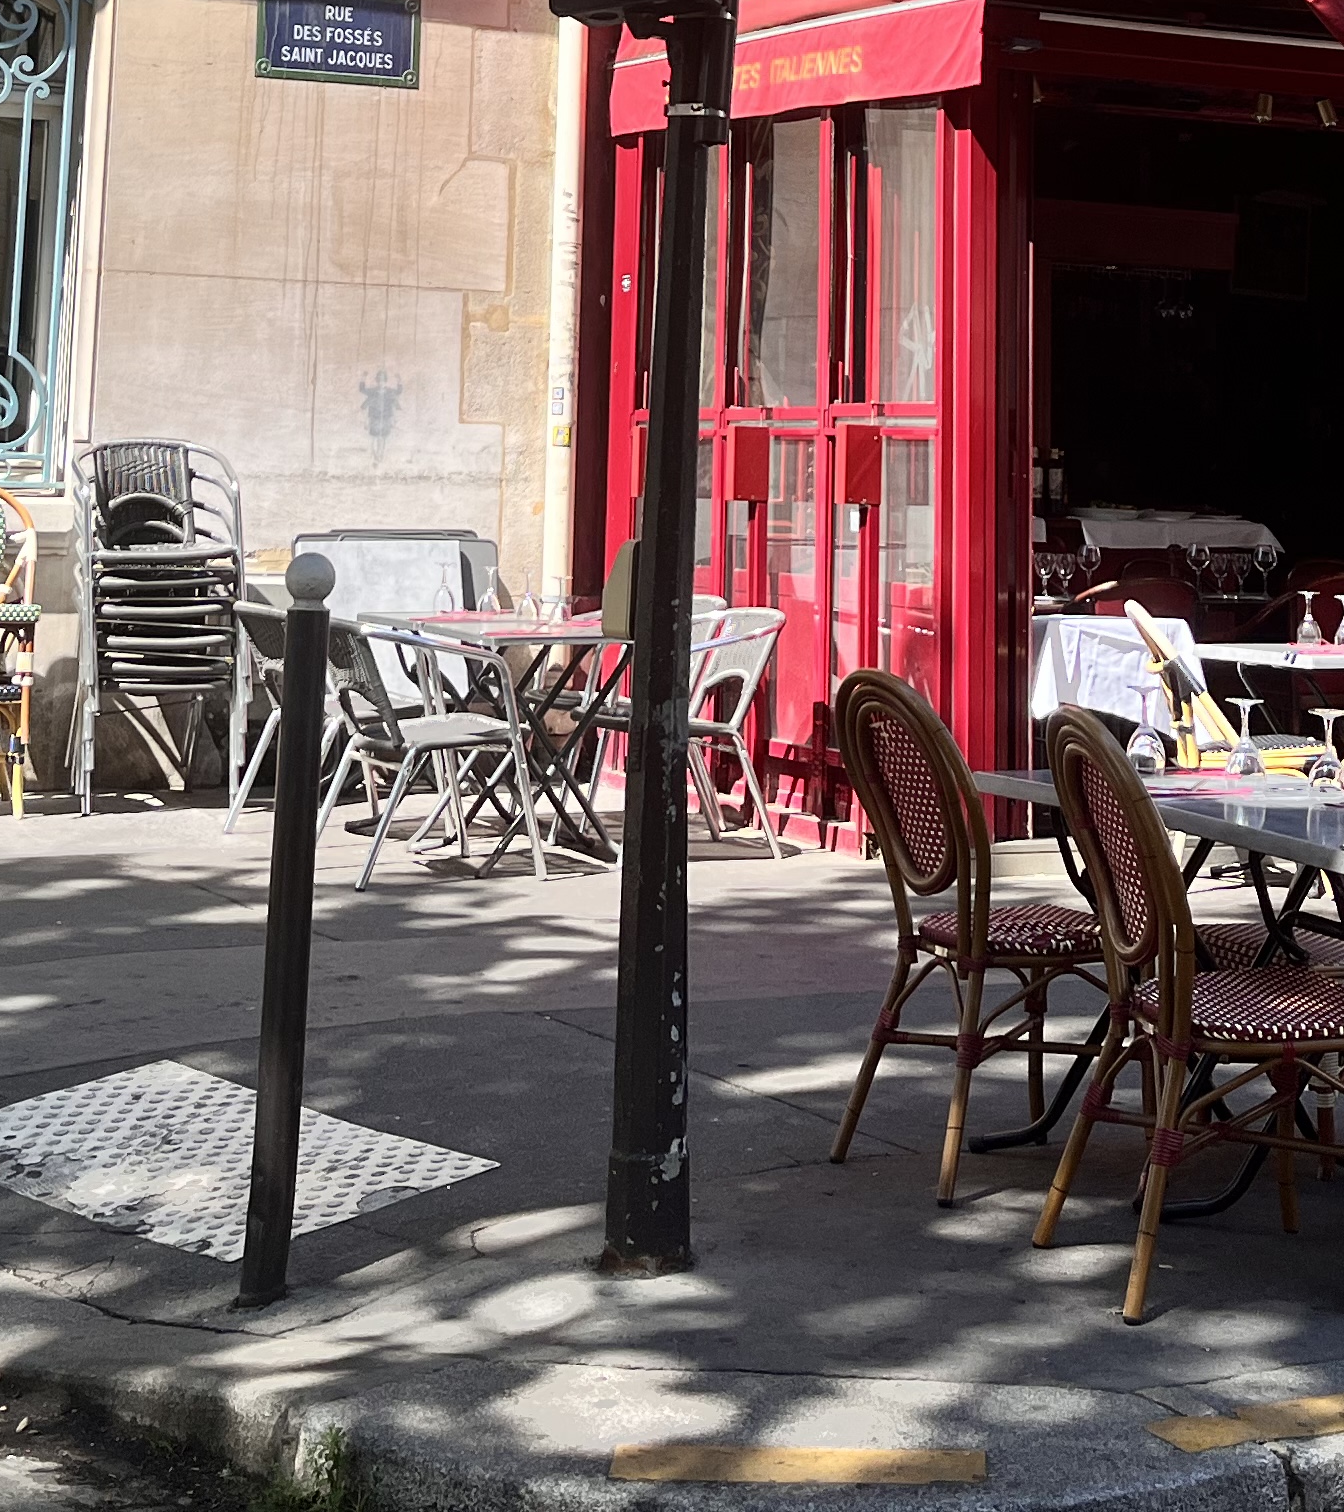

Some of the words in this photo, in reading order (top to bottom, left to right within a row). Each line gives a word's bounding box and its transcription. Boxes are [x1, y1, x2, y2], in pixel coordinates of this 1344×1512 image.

[325, 5, 354, 22] RUE
[293, 25, 321, 42] DES
[325, 27, 383, 47] FOSSÉS
[281, 46, 324, 64] SAINT
[327, 50, 394, 70] JACQUES
[769, 45, 863, 85] ITALIENNES
